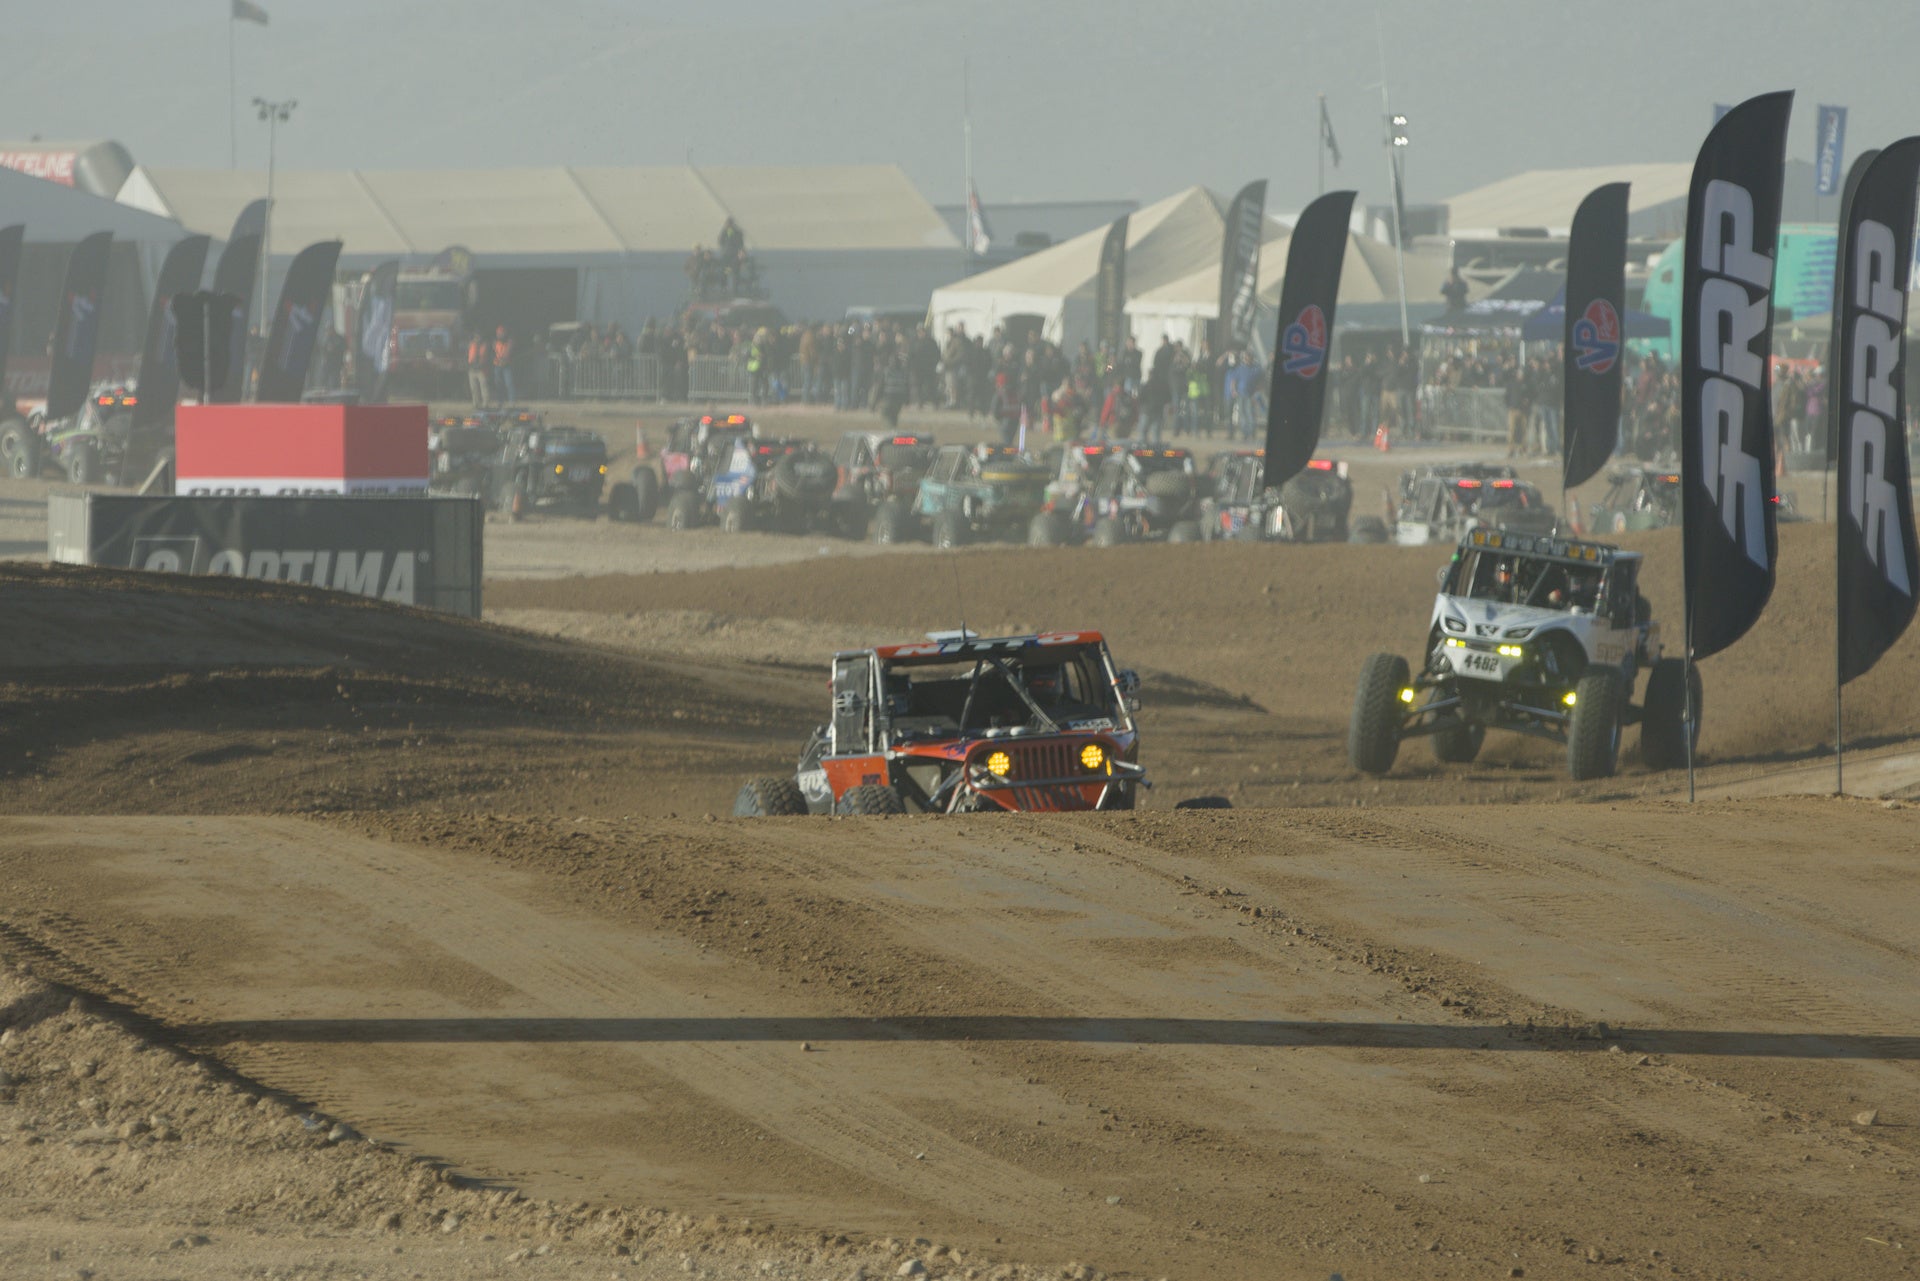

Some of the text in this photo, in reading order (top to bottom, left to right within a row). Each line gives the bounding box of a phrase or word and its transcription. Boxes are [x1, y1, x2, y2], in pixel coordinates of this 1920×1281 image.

[1698, 179, 1774, 572] PRP
[1849, 218, 1912, 598] PRP
[893, 634, 1080, 656] NITTO
